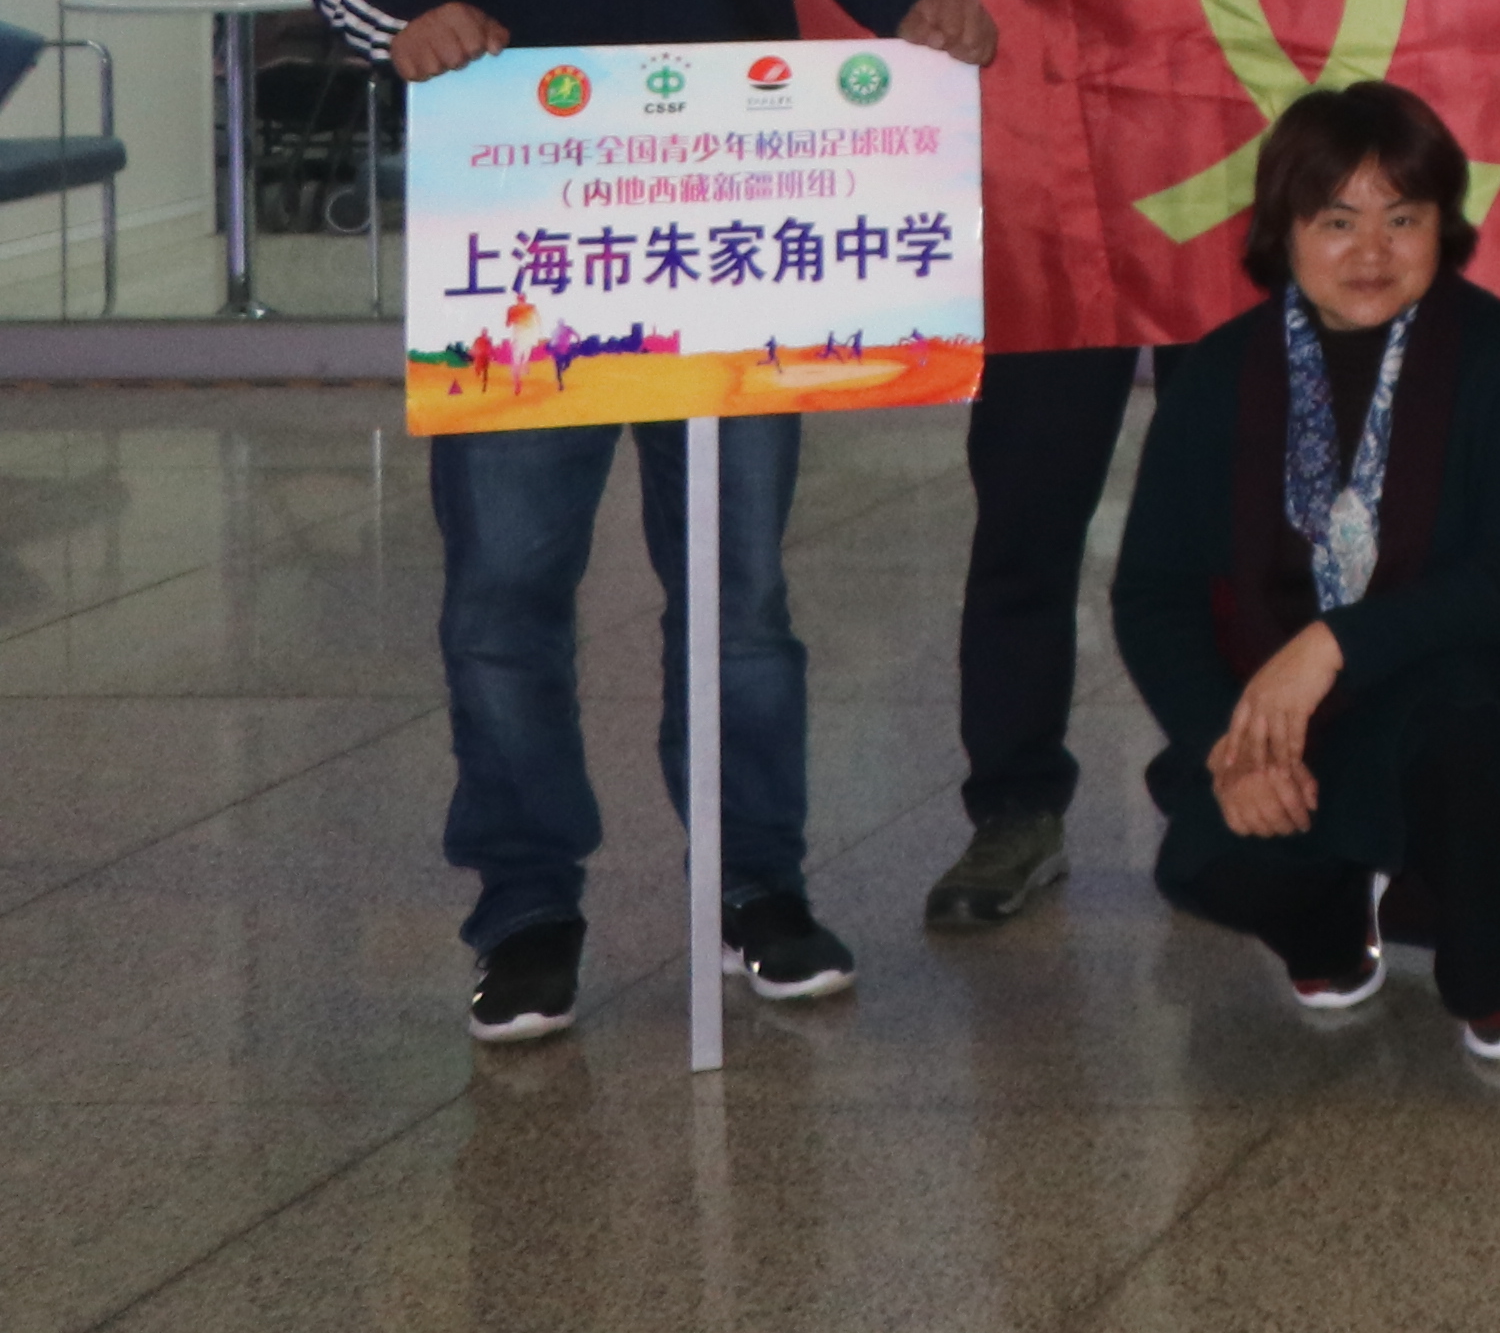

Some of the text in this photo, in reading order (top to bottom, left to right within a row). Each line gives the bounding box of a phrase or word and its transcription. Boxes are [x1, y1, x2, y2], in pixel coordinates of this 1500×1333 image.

[643, 101, 687, 115] CSSF
[469, 124, 941, 168] 2019年全国青少年校园足球联赛
[444, 210, 954, 299] 上海市朱家角中学
